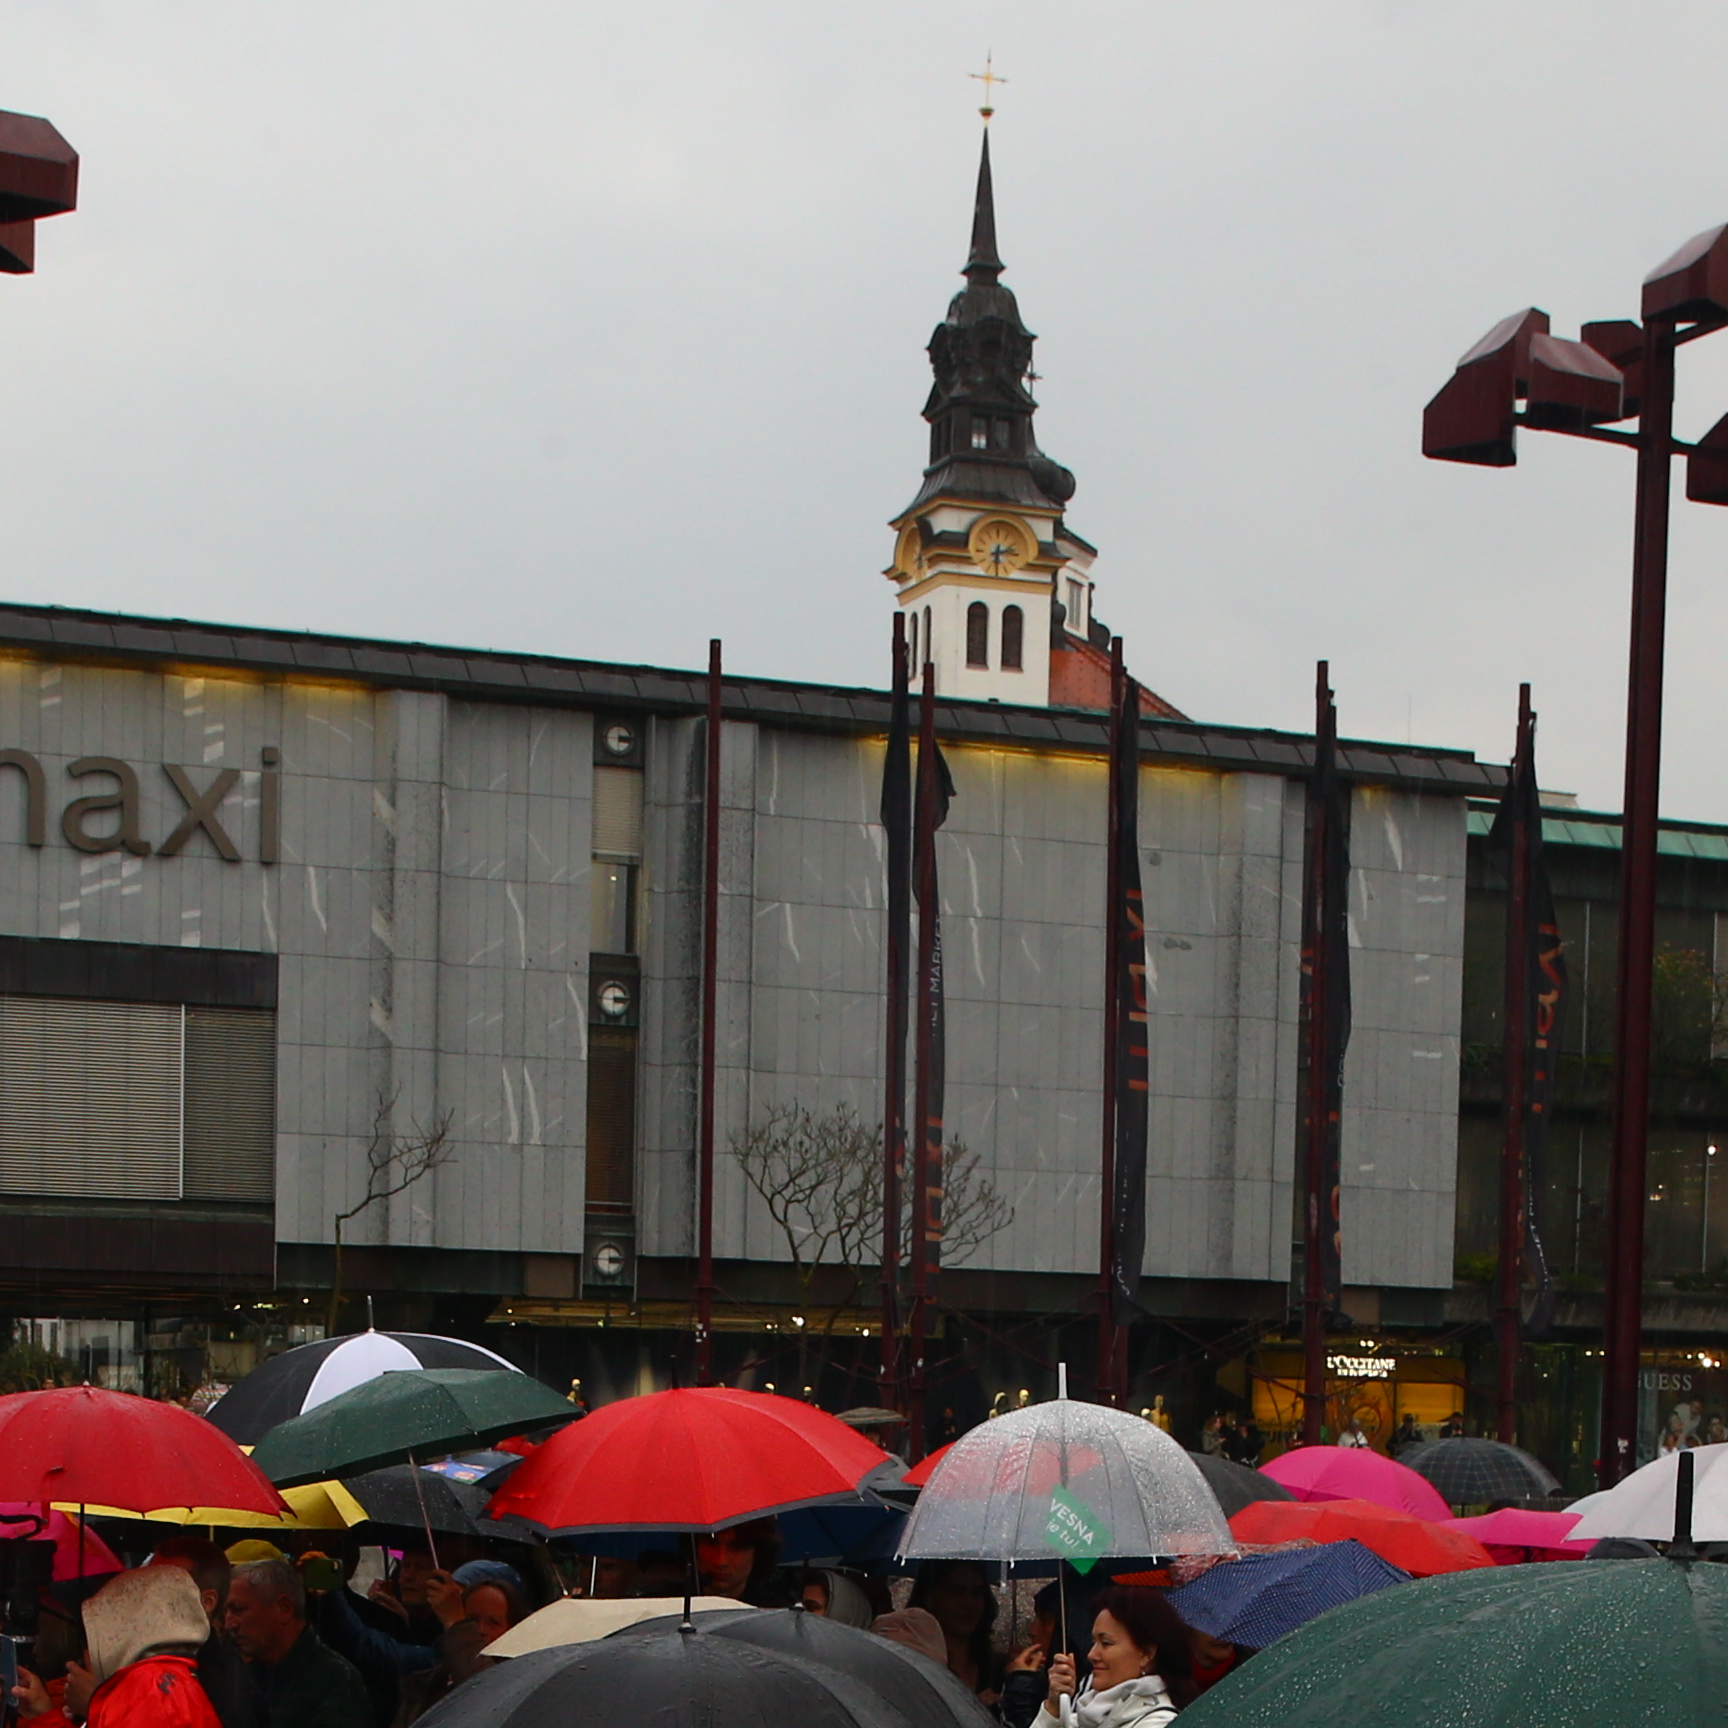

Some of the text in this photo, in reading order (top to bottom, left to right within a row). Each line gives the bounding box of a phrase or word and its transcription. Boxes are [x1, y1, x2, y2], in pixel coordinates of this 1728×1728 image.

[1326, 1355, 1397, 1371] L'OCCITANE
[1638, 1372, 1693, 1391] UESS
[1050, 1498, 1094, 1545] VESNA
